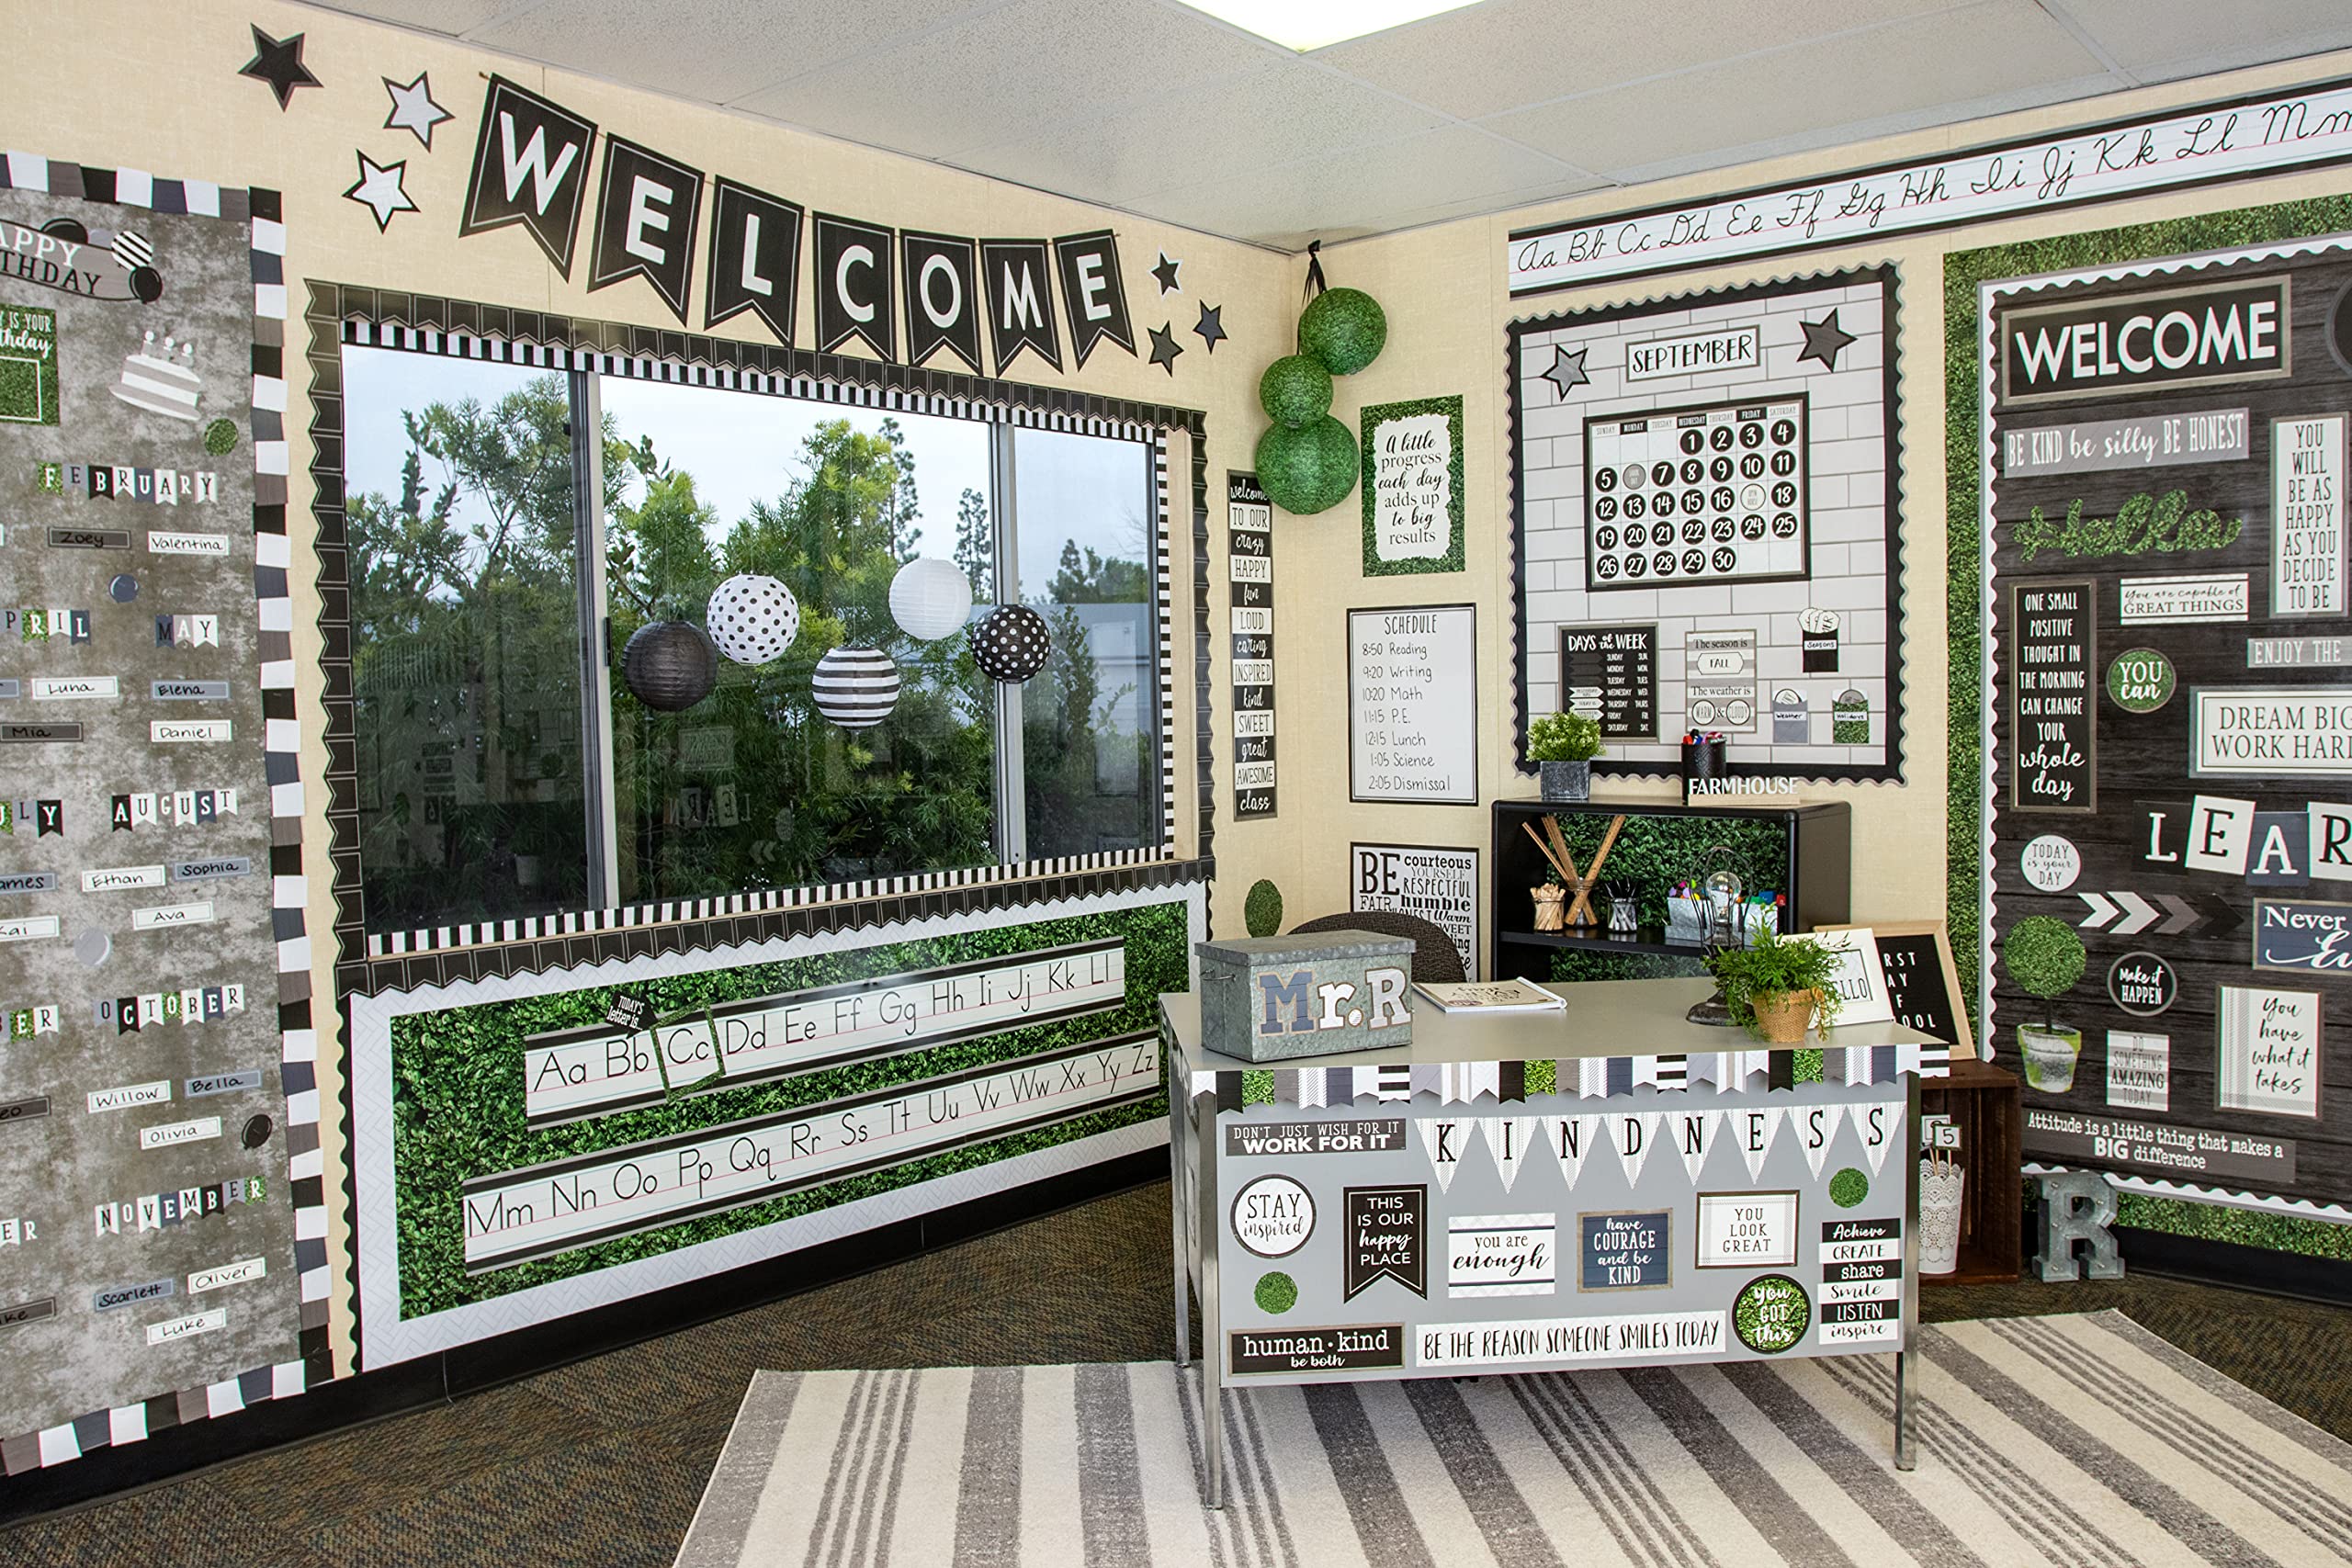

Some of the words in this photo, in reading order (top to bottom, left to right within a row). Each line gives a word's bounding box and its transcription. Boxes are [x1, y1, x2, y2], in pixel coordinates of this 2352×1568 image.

[500, 110, 1112, 330] WELCOME
[2015, 300, 2276, 385] WELCOME
[1633, 334, 1752, 373] SEPTEMBER
[1386, 434, 1396, 454] A
[1401, 430, 1436, 452] little
[2008, 434, 2023, 468] BE
[2031, 429, 2063, 465] KIND
[2070, 430, 2097, 459] be
[2104, 425, 2159, 463] silly
[2163, 419, 2181, 455] BE
[2188, 413, 2244, 451] HONEST
[1381, 452, 1442, 472] progress
[45, 466, 211, 495] FEBRUARY
[1378, 471, 1409, 490] each
[1417, 468, 1445, 491] day
[1385, 491, 1417, 508] adds
[1421, 493, 1440, 509] up
[1599, 501, 1613, 517] 12
[1626, 498, 1642, 515] 13
[1655, 495, 1671, 513] 14
[1685, 492, 1701, 511] 15
[1714, 490, 1731, 508] 16
[1776, 486, 1792, 504] 18
[1232, 507, 1244, 525] TO
[1250, 509, 1267, 528] OUR
[1392, 510, 1405, 526] to
[1411, 506, 1436, 530] big
[152, 536, 223, 550] Valentina
[1236, 534, 1264, 555] crazy
[1389, 528, 1436, 545] results
[1235, 558, 1267, 578] HAPPY
[1244, 583, 1259, 605] fun
[2025, 593, 2044, 612] ONE
[2048, 592, 2077, 611] SMALL
[2123, 600, 2174, 615] GREAT
[2179, 598, 2245, 614] THINGS
[158, 618, 210, 640] MAY
[1240, 612, 1264, 630] LOUD
[1385, 614, 1437, 635] SCHEDULE
[2030, 617, 2074, 637] POSITIVE
[1568, 635, 1597, 651] DAYS
[1599, 641, 1615, 649] the
[1601, 633, 1613, 641] of
[1615, 633, 1647, 650] WEEK
[1695, 639, 1711, 649] The
[1712, 639, 1739, 649] season
[1740, 637, 1747, 648] is
[1237, 638, 1267, 658] caring
[1362, 642, 1383, 656] 8:50
[1389, 642, 1427, 660] Reading
[2023, 645, 2065, 663] THOUGHT
[2069, 644, 2081, 662] IN
[1235, 663, 1272, 682] INSPIRED
[1710, 658, 1730, 669] FALL
[2119, 661, 2164, 683] YOU
[1363, 666, 1383, 679] 9:20
[1389, 666, 1432, 682] Writing
[2019, 671, 2037, 689] THE
[2040, 671, 2085, 689] MORNING
[49, 682, 95, 694] Luna
[158, 682, 205, 696] Elena
[1243, 687, 1264, 708] kind
[1391, 687, 1423, 701] Math
[2120, 683, 2161, 701] can
[1392, 708, 1411, 724] P.E.
[2020, 697, 2041, 716] CAN
[2044, 697, 2083, 716] CHANGE
[160, 727, 212, 739] Daniel
[1239, 714, 1270, 733] SWEET
[2037, 722, 2066, 741] YOUR
[1392, 731, 1426, 747] Lunch
[1242, 736, 1268, 762] great
[2020, 742, 2086, 769] whole
[1393, 752, 1435, 767] Science
[1237, 766, 1273, 785] AWESOME
[1394, 775, 1451, 791] Dismissal
[1689, 777, 1798, 795] FARMHOUSE
[2031, 770, 2075, 801] day
[114, 791, 230, 822] AUGUST
[1240, 790, 1271, 811] class
[2031, 843, 2069, 859] TODAY
[182, 862, 238, 877] Sophia
[1411, 866, 1465, 880] YOURSELF
[2028, 857, 2038, 867] is
[2043, 858, 2073, 870] your
[1359, 852, 1400, 896] BE
[1404, 854, 1472, 870] courteous
[2039, 871, 2062, 886] DAY
[1404, 877, 1470, 898] RESPECTFUL
[1360, 895, 1392, 912] FAIR
[1400, 895, 1471, 912] humble
[1434, 910, 1472, 923] Warm
[101, 988, 237, 1025] OCTOBER
[618, 995, 645, 1015] TODAY'S
[534, 1051, 586, 1092] Aa
[606, 1037, 649, 1077] Bb
[667, 1028, 709, 1065] Cc
[726, 1014, 766, 1055] Dd
[786, 1007, 817, 1043] Ee
[835, 998, 863, 1034] Ff
[879, 991, 916, 1036] Gg
[933, 980, 964, 1015] Hh
[978, 975, 991, 1006] Ii
[1008, 969, 1030, 1012] Jj
[1048, 961, 1075, 993] Kk
[1091, 953, 1109, 985] Ll
[606, 1005, 631, 1025] letter
[96, 1088, 159, 1108] Willow
[151, 1125, 198, 1143] Olivia
[1234, 1126, 1272, 1139] DON'T
[1281, 1125, 1309, 1137] JUST
[1317, 1122, 1349, 1135] WISH
[1357, 1122, 1380, 1134] FOR
[1387, 1122, 1399, 1133] IT
[1436, 1107, 1883, 1163] KINDNESS
[2029, 1111, 2082, 1134] Attitude
[2085, 1119, 2099, 1135] is
[2101, 1124, 2109, 1137] a
[2113, 1122, 2153, 1144] little
[2155, 1127, 2195, 1151] thing
[2198, 1132, 2228, 1152] that
[2231, 1139, 2271, 1157] makes
[2274, 1145, 2284, 1158] a
[1242, 1137, 1313, 1154] WORK
[1319, 1135, 1363, 1151] FOR
[1370, 1134, 1390, 1149] IT
[2094, 1137, 2129, 1160] BIG
[2133, 1145, 2206, 1169] difference
[101, 1179, 264, 1227] NOVEMBER
[1367, 1197, 1404, 1210] THIS
[1357, 1214, 1372, 1227] IS
[1378, 1213, 1413, 1225] OUR
[1359, 1229, 1412, 1252] happy
[1832, 1224, 1886, 1240] Achieve
[1361, 1253, 1411, 1266] PLACE
[1833, 1244, 1885, 1259] CREATE
[1840, 1264, 1884, 1280] share
[1831, 1283, 1883, 1299] Smile
[1838, 1303, 1883, 1322] LISTEN
[162, 1317, 205, 1337] Luke
[1831, 1323, 1886, 1340] inspire
[1425, 1333, 1442, 1360] BE
[1449, 1332, 1475, 1359] THE
[1482, 1329, 1539, 1357] REASON
[1545, 1325, 1611, 1355] SOMEONE
[1619, 1322, 1668, 1351] SMILES
[1674, 1320, 1719, 1348] TODAY
